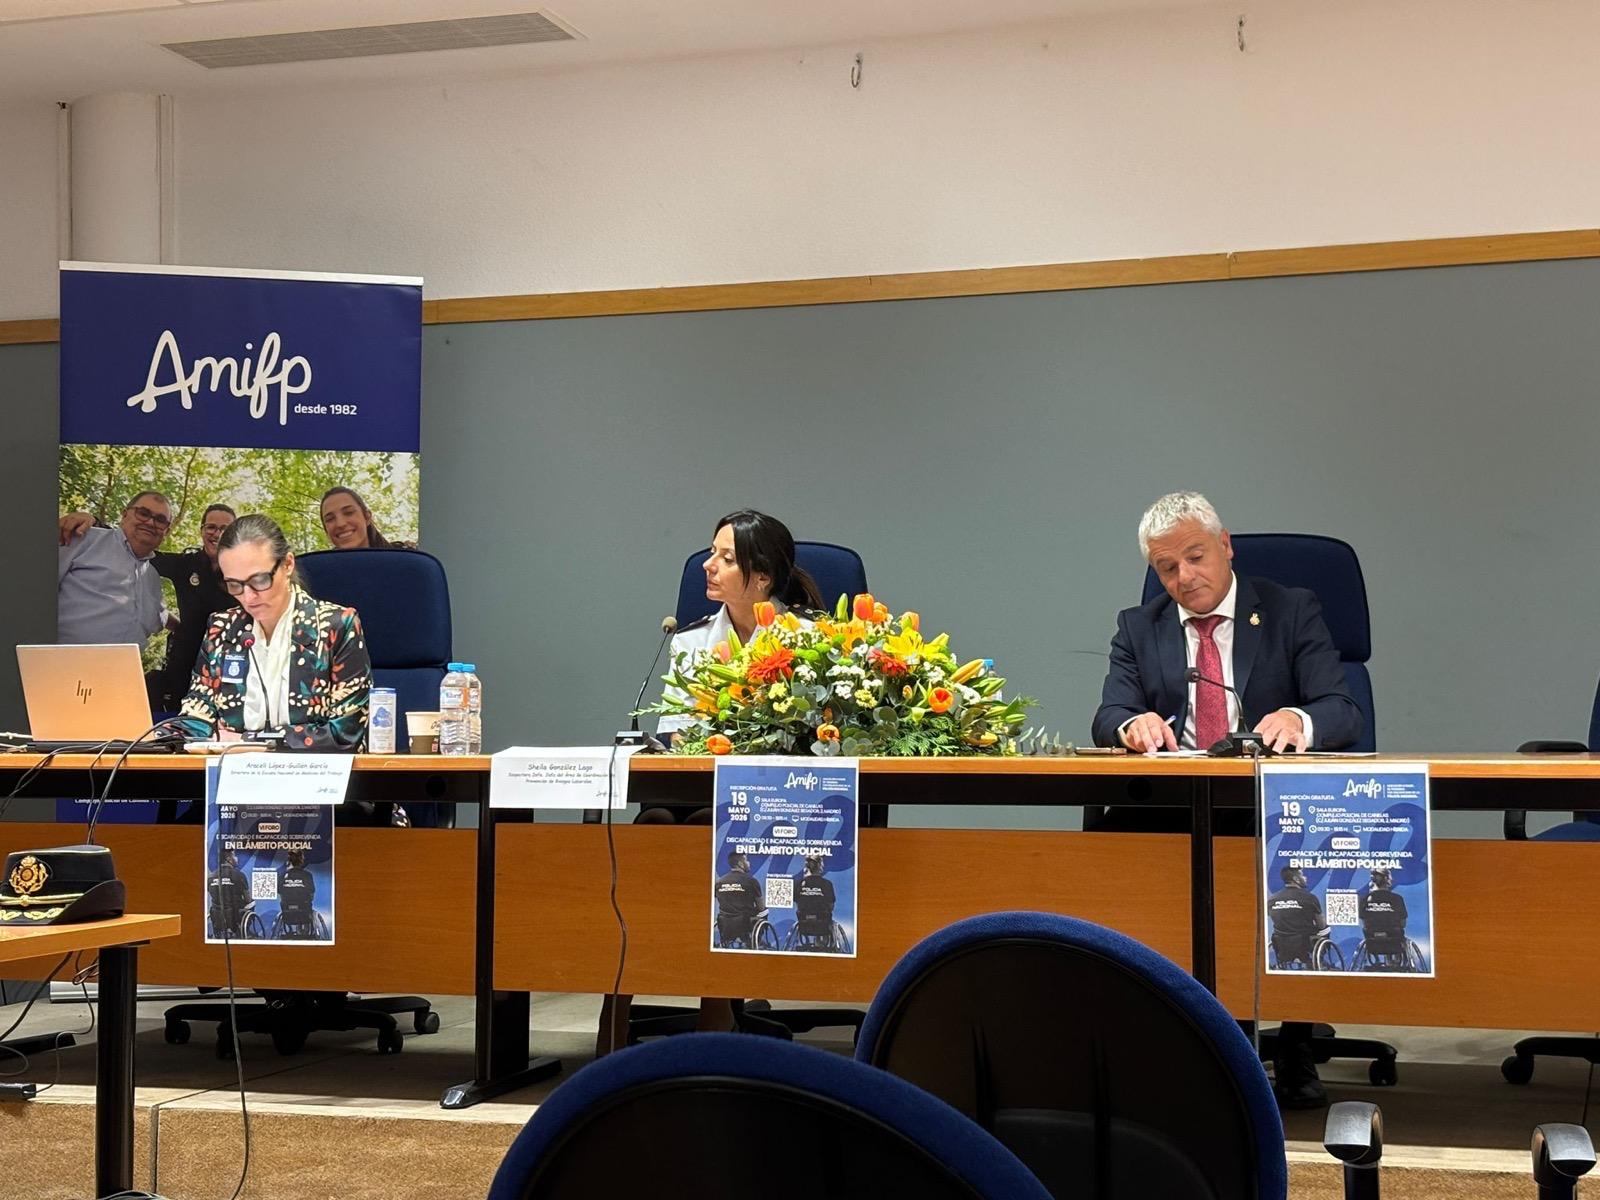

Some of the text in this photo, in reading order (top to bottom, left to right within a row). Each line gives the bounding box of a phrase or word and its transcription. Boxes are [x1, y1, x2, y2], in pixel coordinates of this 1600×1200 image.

[126, 330, 312, 426] Amifp
[294, 403, 357, 416] desde 1982
[76, 680, 92, 704] hp
[784, 772, 818, 791] Amifp
[1342, 778, 1382, 799] Amifp
[731, 792, 747, 806] 19
[1282, 801, 1300, 817] 19
[246, 840, 277, 849] ÁMBITO
[736, 844, 832, 856] EN EL ÁMBITO POLICIAL
[1290, 857, 1402, 869] EN EL ÁMBITO POLICIAL
